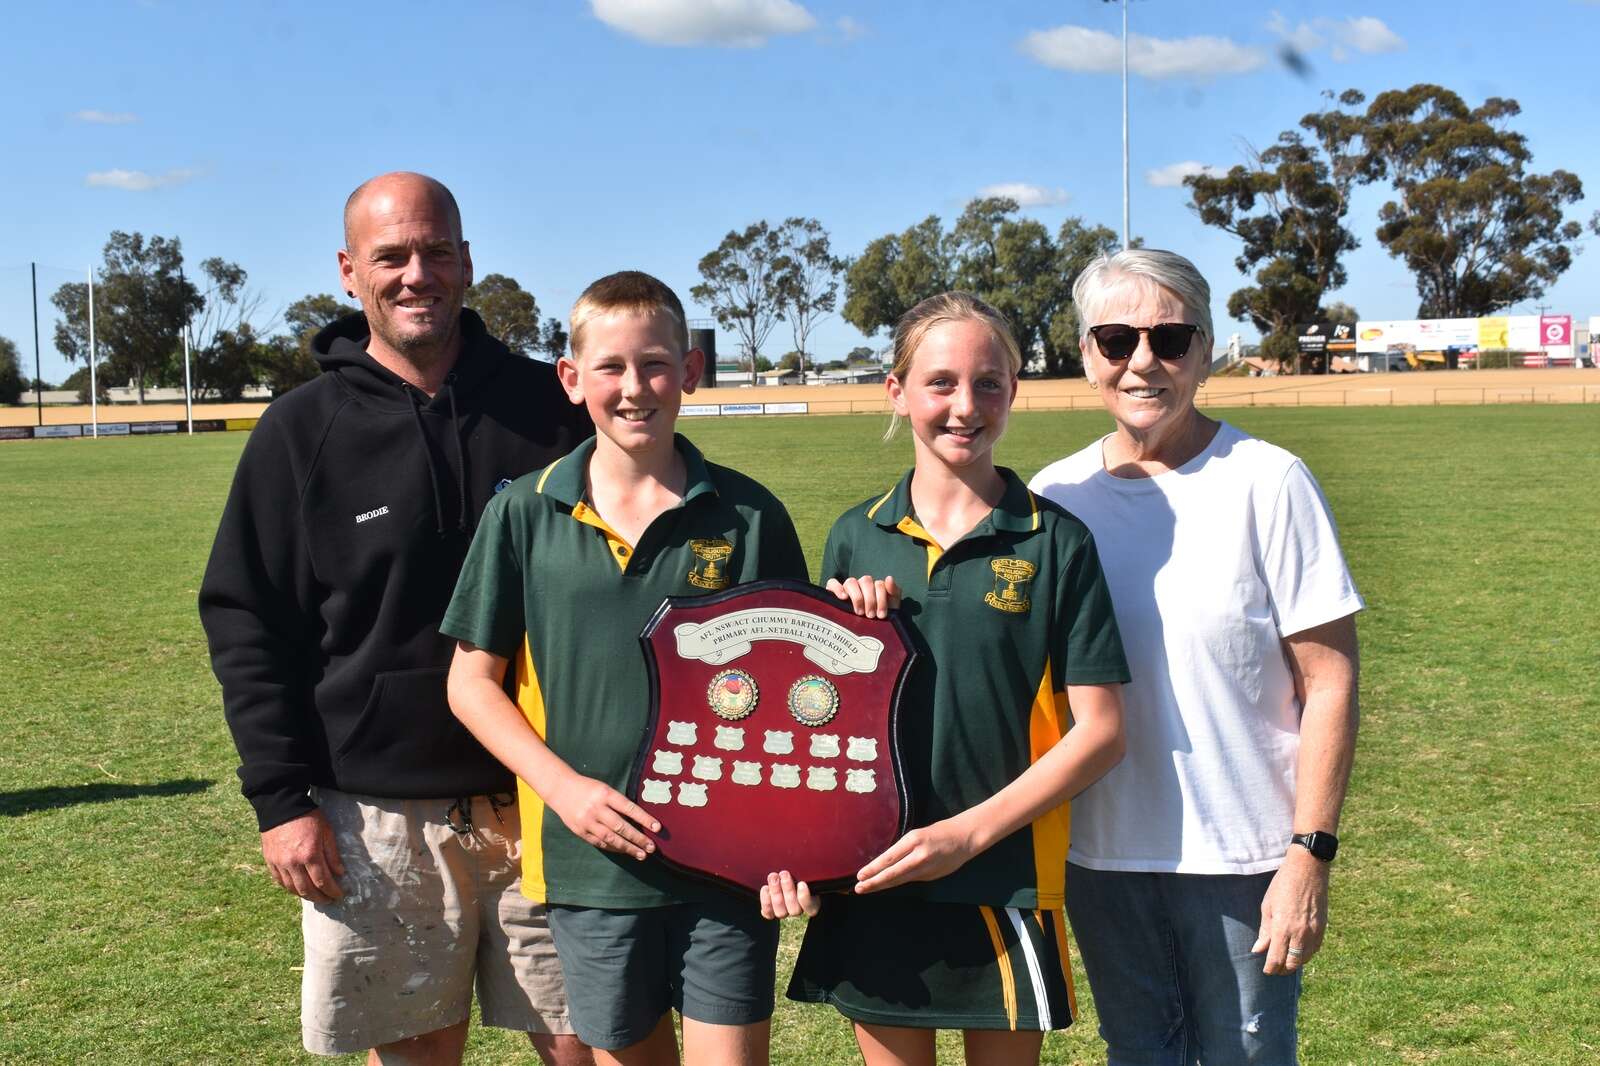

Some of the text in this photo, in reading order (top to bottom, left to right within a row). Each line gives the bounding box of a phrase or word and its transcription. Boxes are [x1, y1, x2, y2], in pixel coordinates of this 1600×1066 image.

[355, 505, 389, 523] BRODIE
[699, 630, 714, 642] AFL
[752, 616, 788, 625] CHUMMY
[791, 618, 831, 636] BARTLETT
[832, 632, 859, 654] SHIELD
[713, 626, 849, 659] PRIMARY AFL-NETBALL KNOCKOUT
